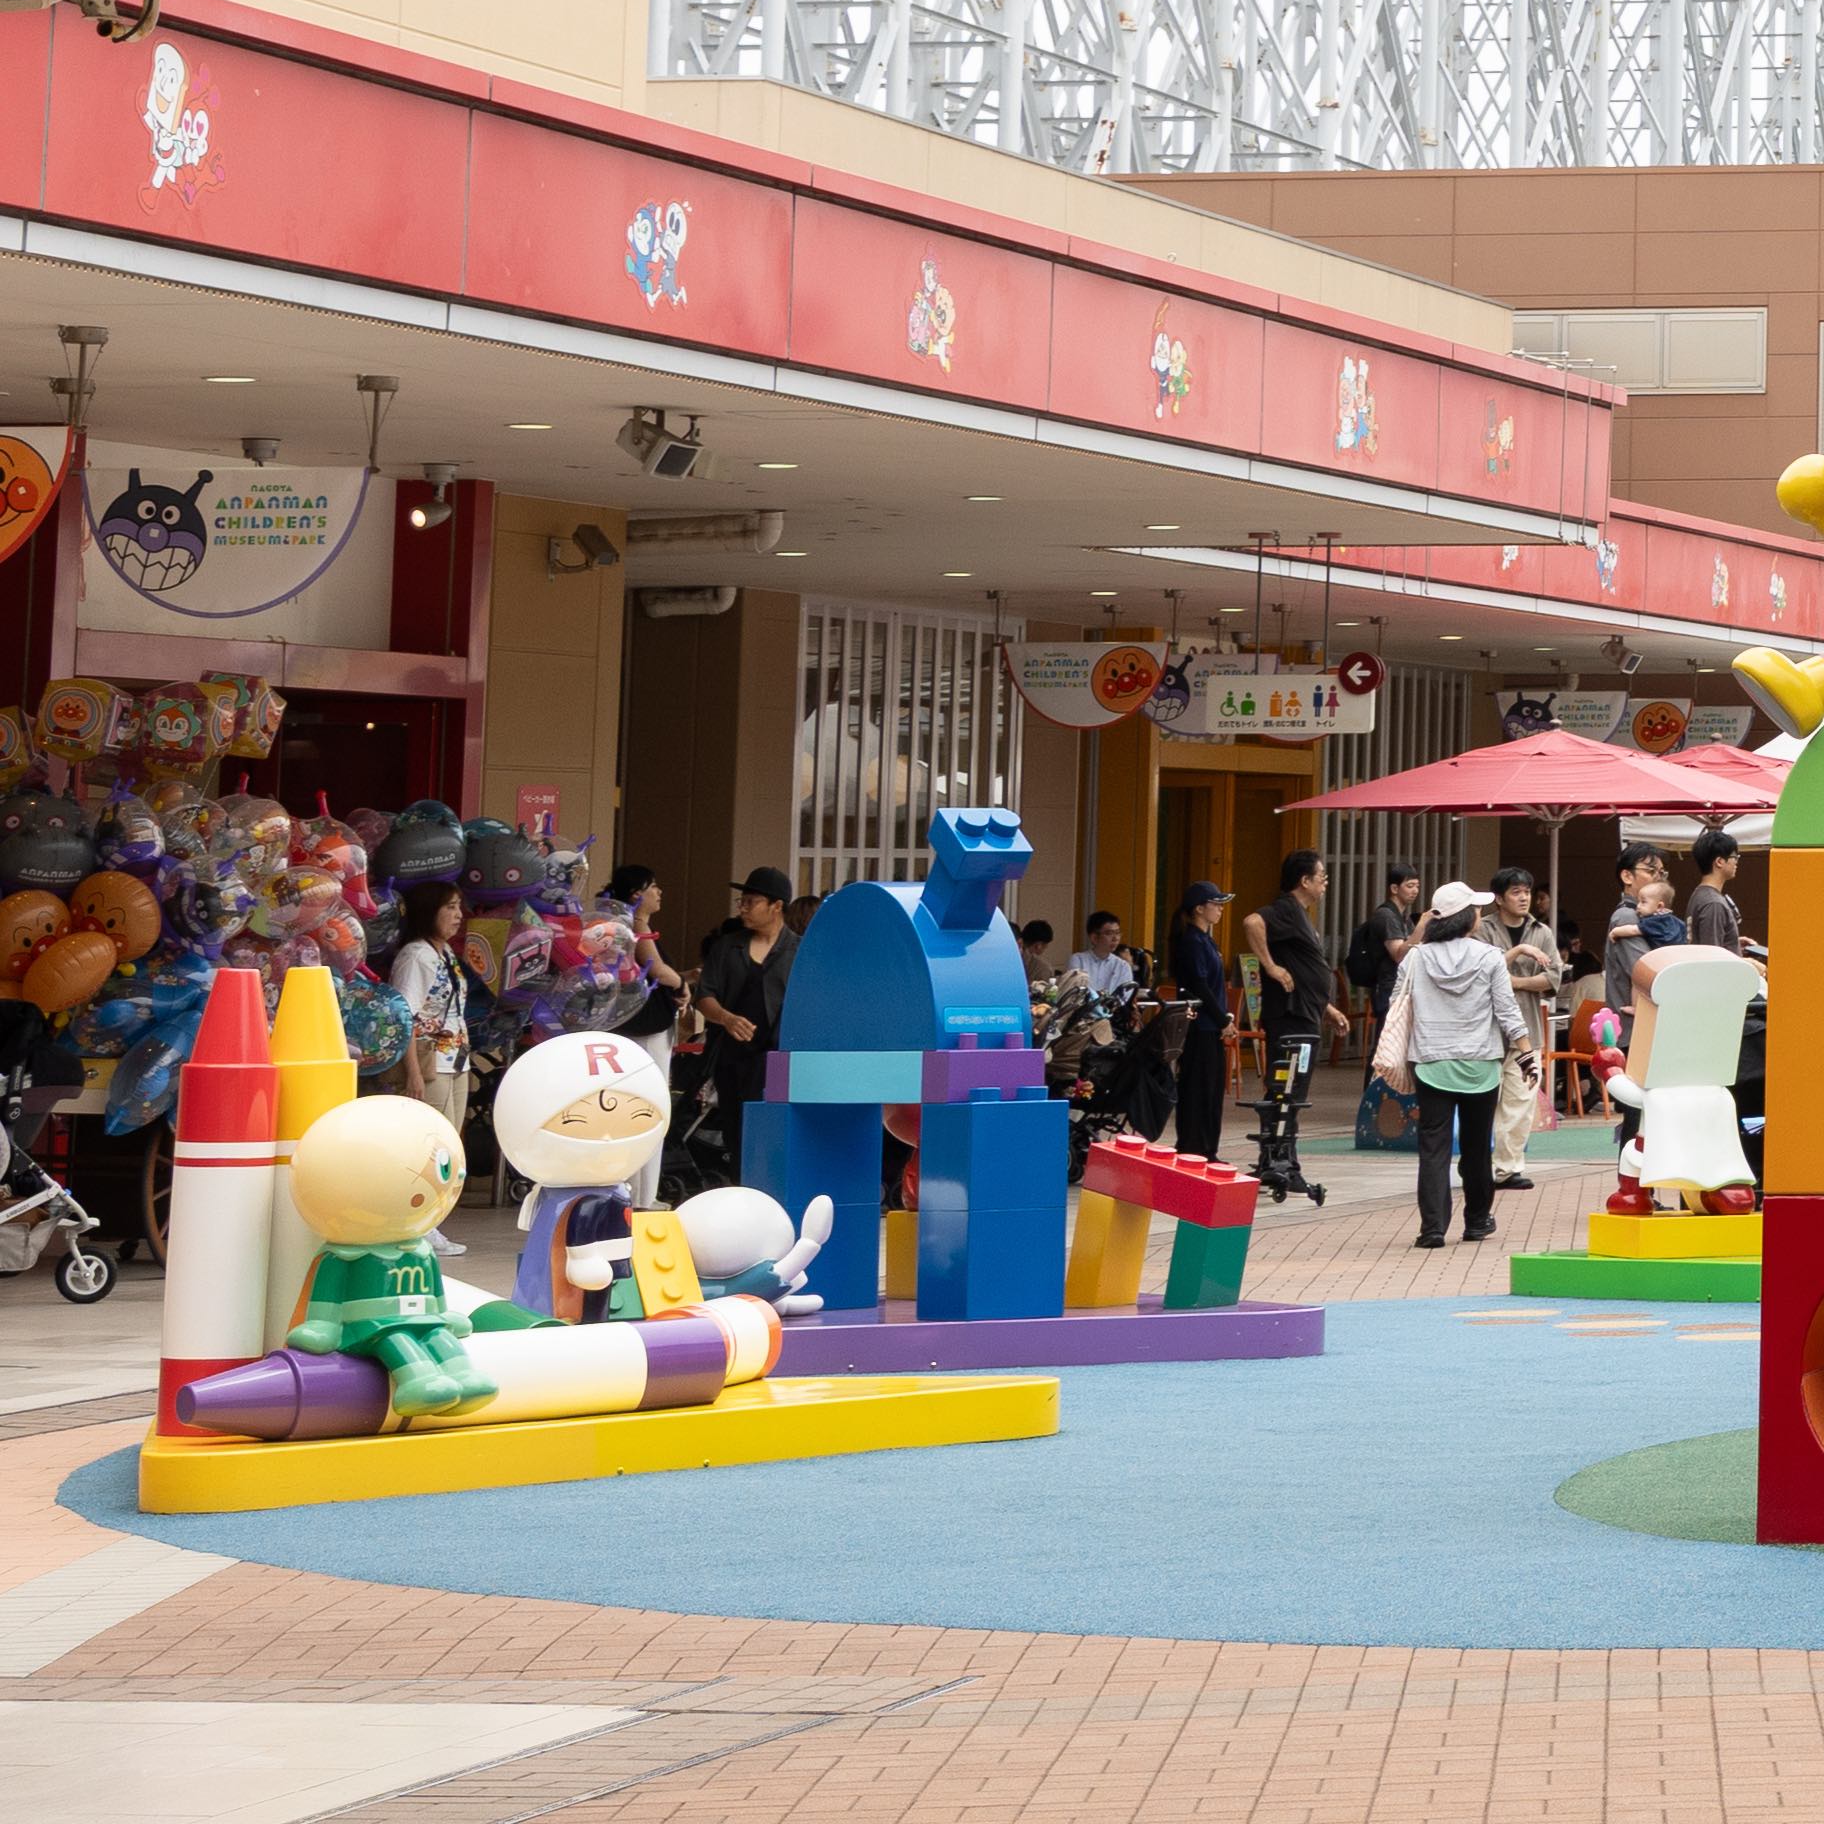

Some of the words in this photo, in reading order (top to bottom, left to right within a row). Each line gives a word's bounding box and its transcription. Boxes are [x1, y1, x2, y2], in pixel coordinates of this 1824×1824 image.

[250, 484, 293, 493] NAGOYA
[215, 495, 328, 509] ANPANMAN
[214, 515, 327, 529] CHILDREN'S
[1316, 719, 1337, 728] トイレ
[584, 1043, 625, 1076] R
